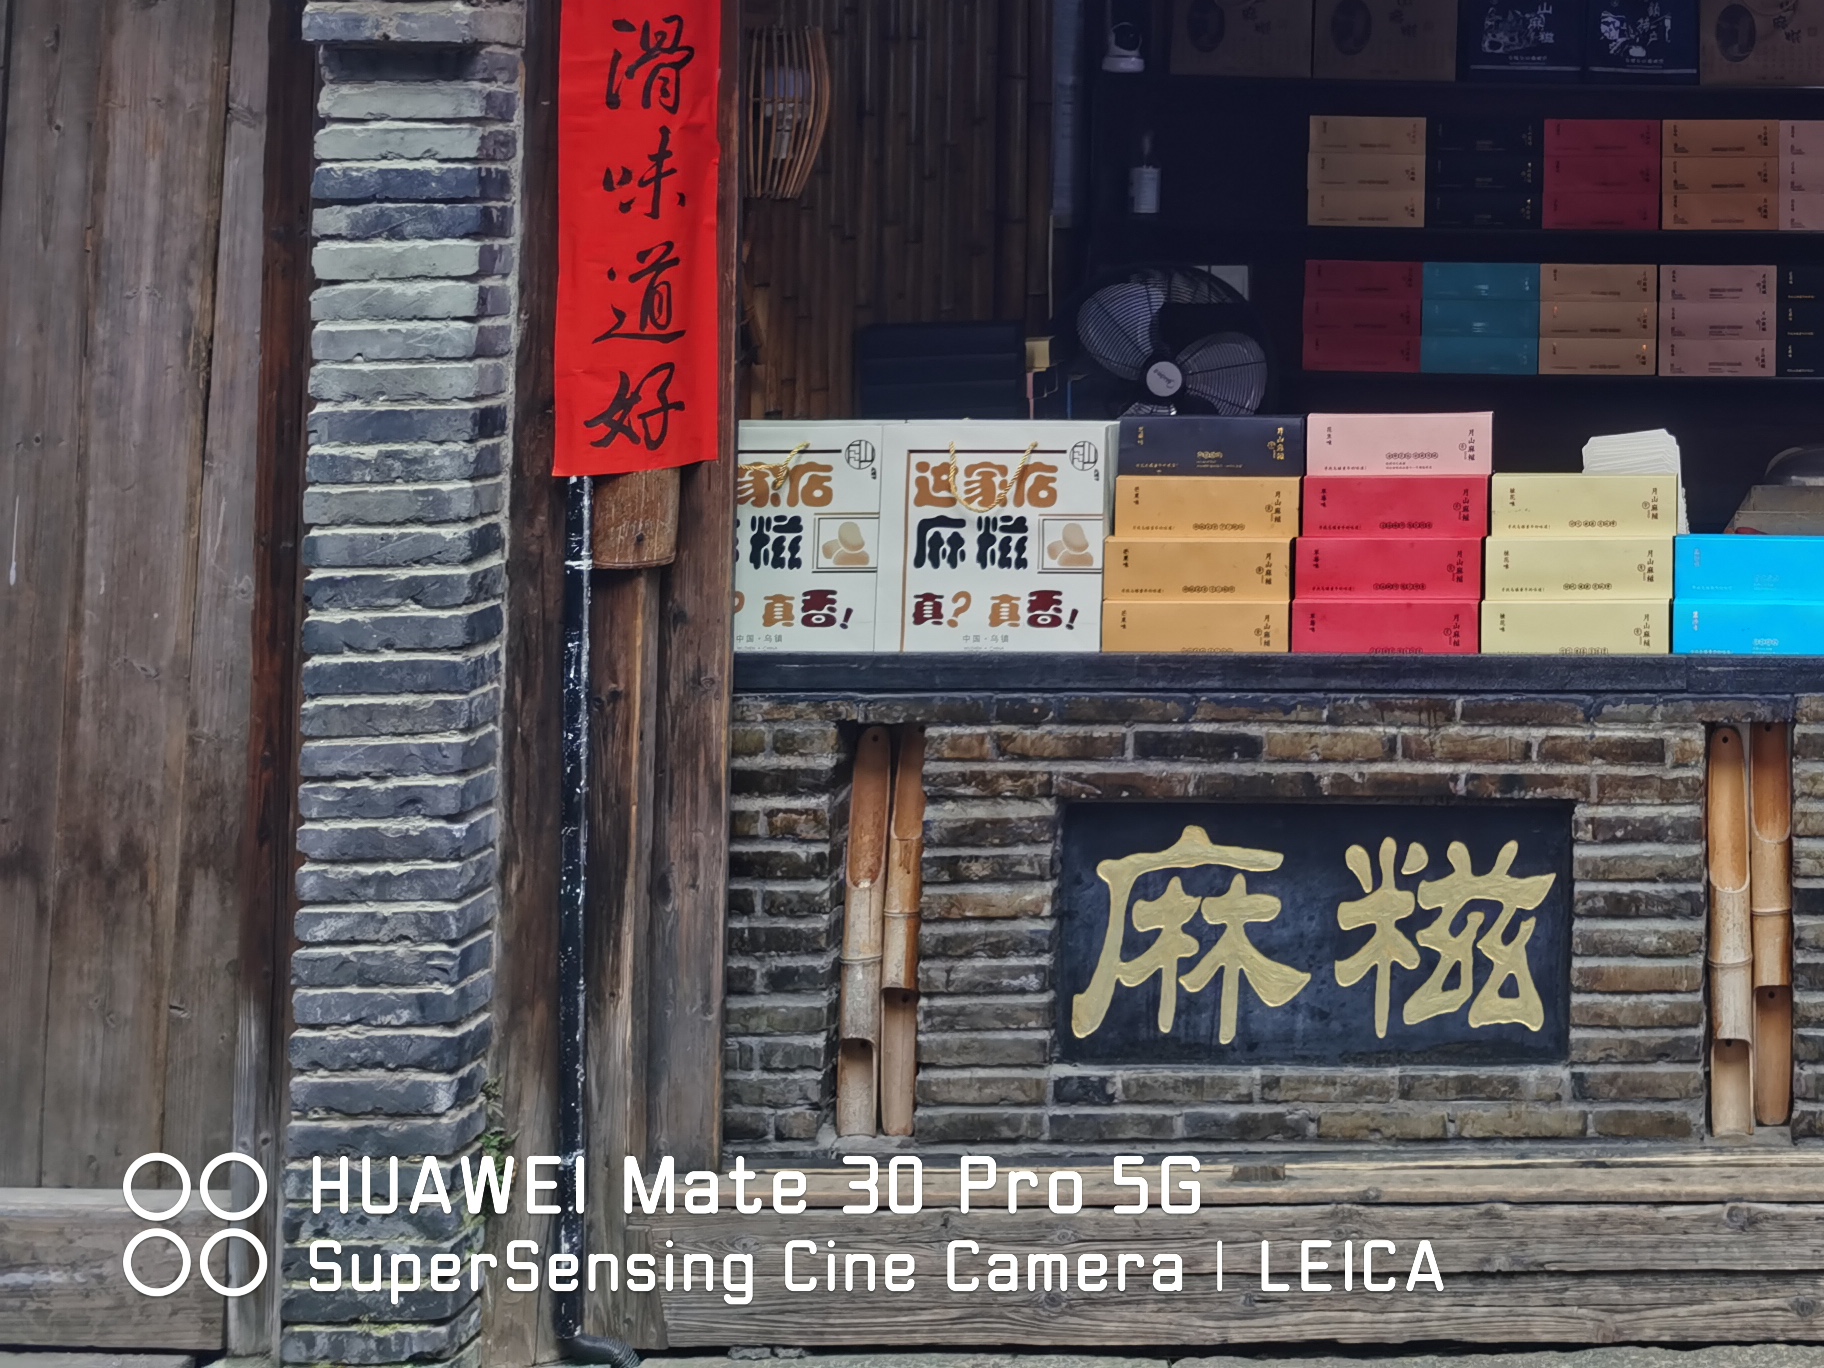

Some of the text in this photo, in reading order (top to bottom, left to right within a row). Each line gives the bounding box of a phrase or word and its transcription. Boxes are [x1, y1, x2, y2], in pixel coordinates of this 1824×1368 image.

[736, 515, 803, 570] 糍
[913, 514, 1029, 570] 麻糍
[1071, 825, 1556, 1045] 麻糍
